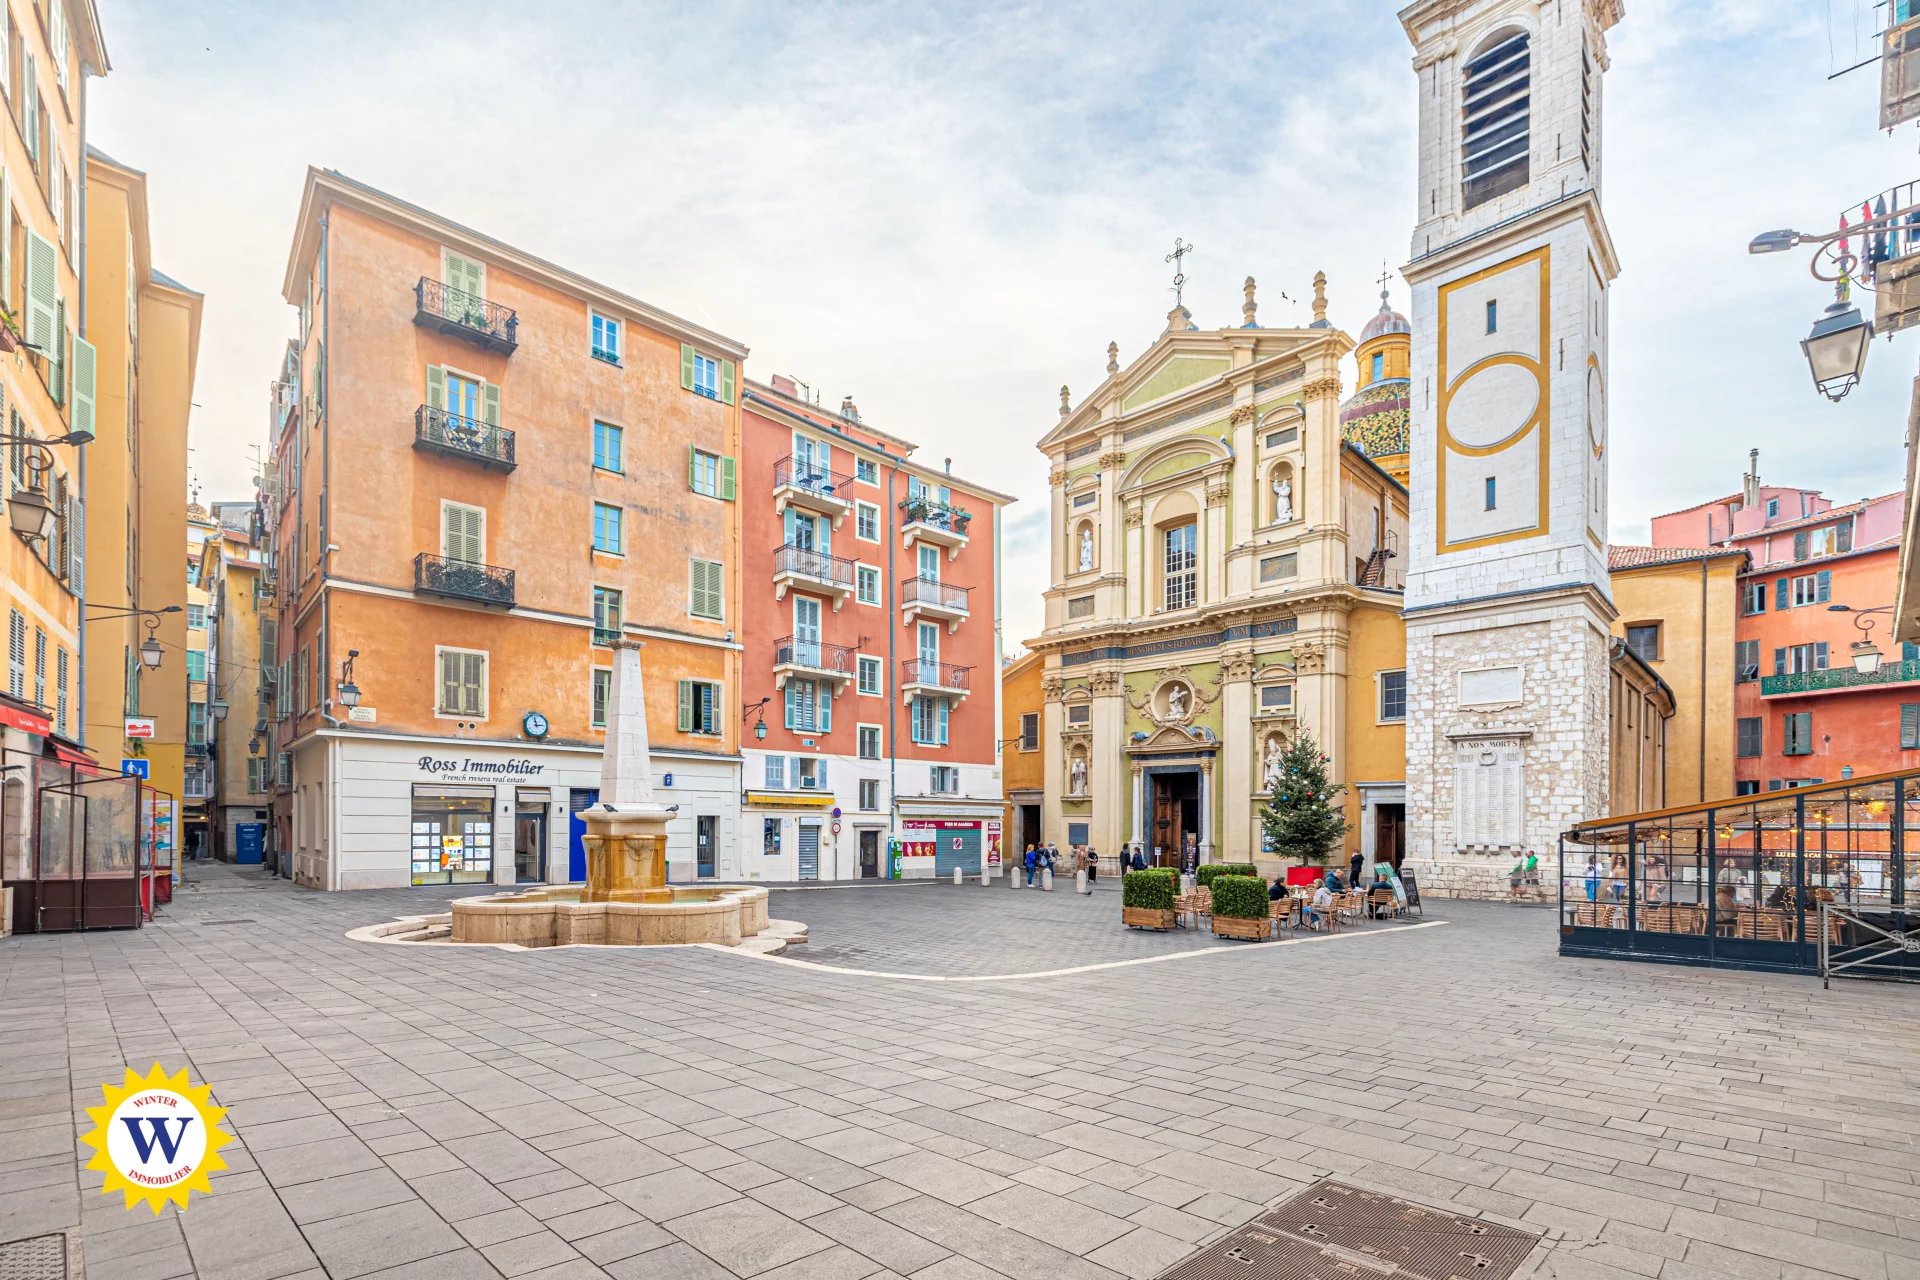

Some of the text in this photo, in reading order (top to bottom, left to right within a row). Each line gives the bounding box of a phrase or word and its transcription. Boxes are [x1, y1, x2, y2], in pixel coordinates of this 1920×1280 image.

[1489, 740, 1517, 748] MORTS
[418, 756, 544, 775] Ross Immobilier
[441, 773, 467, 781] French
[492, 775, 505, 783] real
